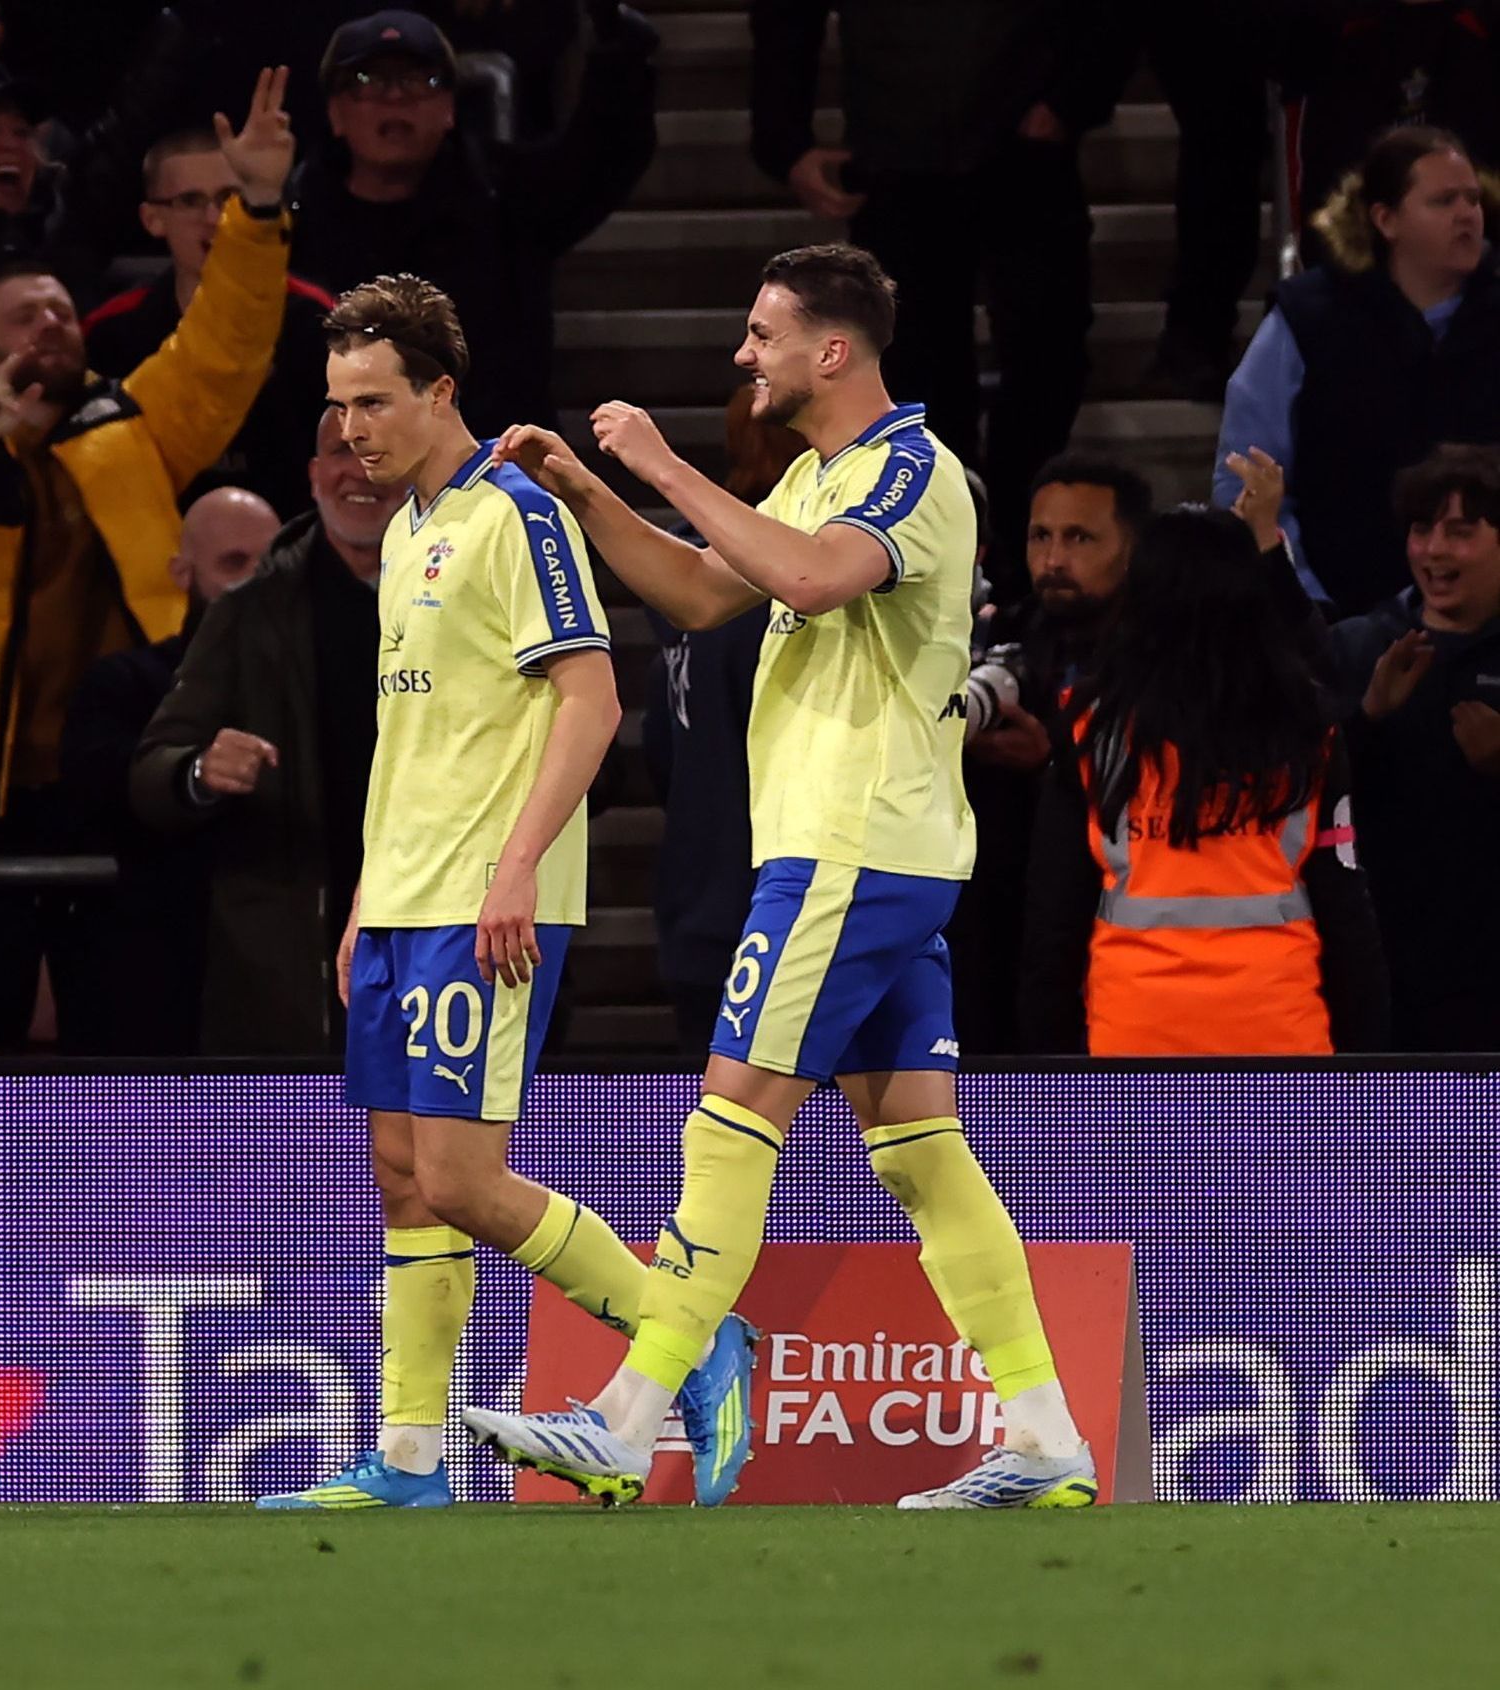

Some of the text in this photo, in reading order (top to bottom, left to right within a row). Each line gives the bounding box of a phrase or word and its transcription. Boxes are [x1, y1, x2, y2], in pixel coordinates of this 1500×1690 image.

[542, 537, 578, 629] GARMIN
[727, 931, 770, 1004] 6
[401, 981, 483, 1058] 20
[764, 1390, 855, 1445] FA
